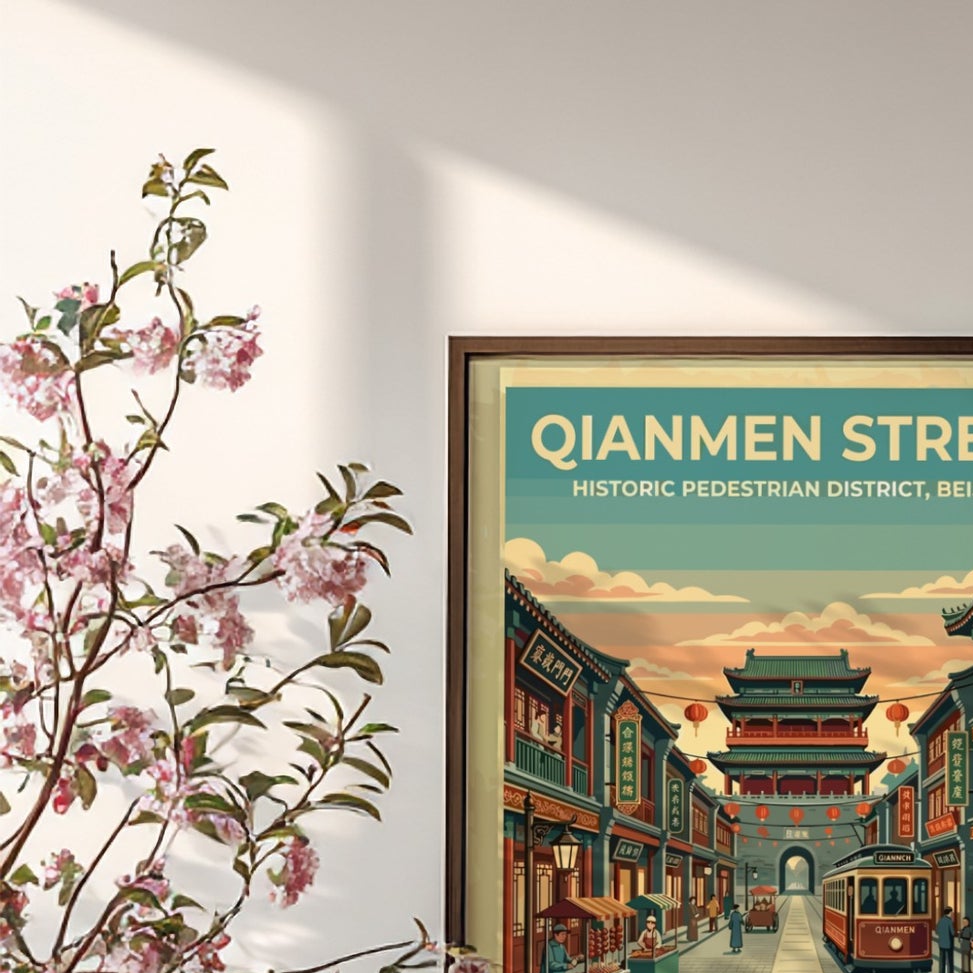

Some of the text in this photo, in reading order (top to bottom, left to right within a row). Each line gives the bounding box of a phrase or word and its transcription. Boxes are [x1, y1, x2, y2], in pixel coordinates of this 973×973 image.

[531, 414, 821, 471] QIANMEN
[573, 480, 675, 498] HISTORIC
[682, 480, 820, 498] PEDESTRIAN
[827, 480, 931, 501] DISTRICT,
[875, 926, 915, 934] QIANMEN
